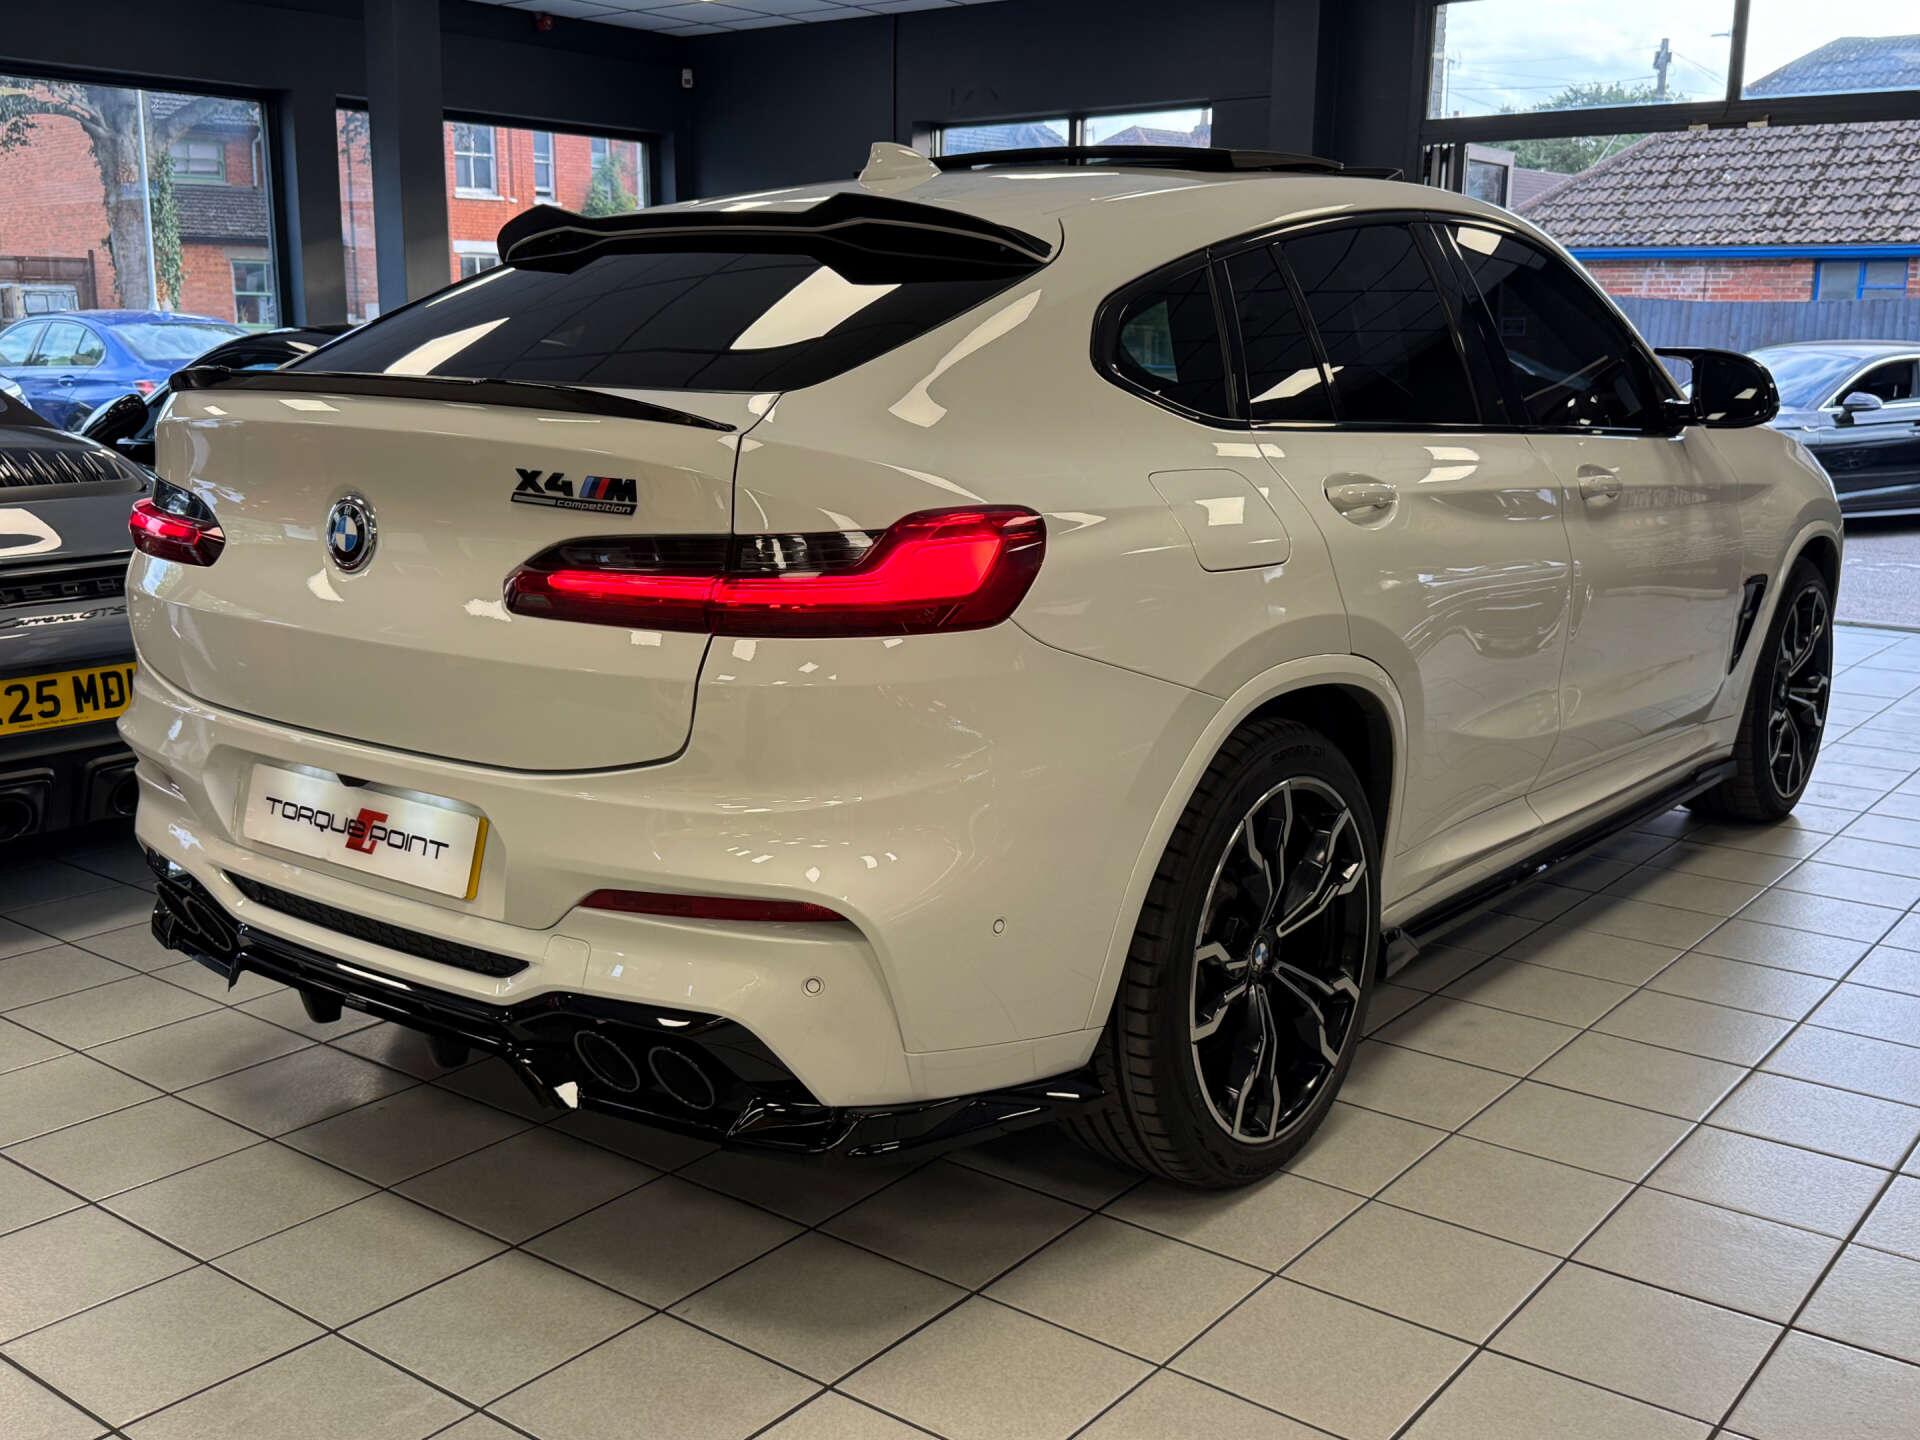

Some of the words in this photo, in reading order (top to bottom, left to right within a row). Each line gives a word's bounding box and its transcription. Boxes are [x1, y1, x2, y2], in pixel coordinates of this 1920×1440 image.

[515, 468, 574, 497] X4
[555, 499, 632, 514] competition
[0, 679, 61, 724] 25
